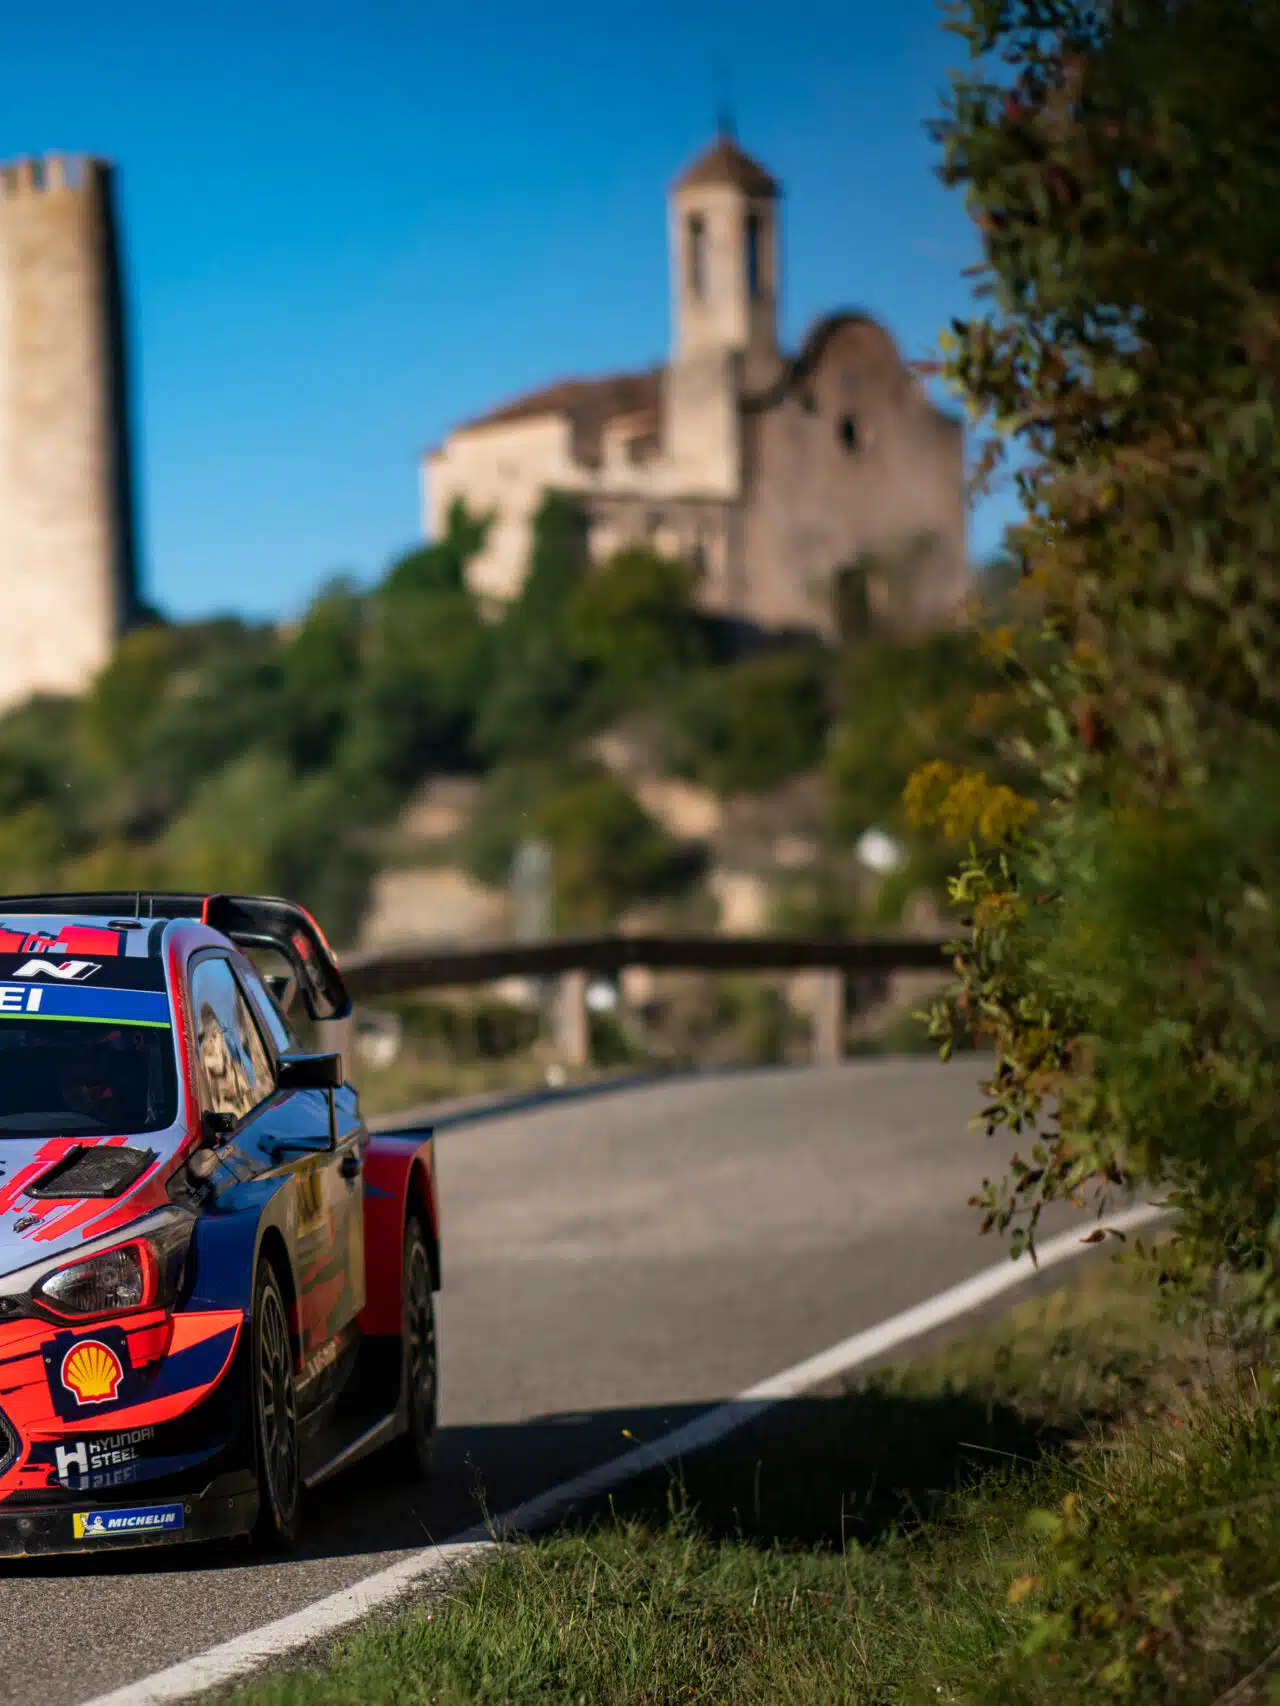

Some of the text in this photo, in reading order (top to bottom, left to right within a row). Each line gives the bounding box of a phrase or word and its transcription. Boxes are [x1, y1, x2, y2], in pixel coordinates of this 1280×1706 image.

[89, 1426, 156, 1454] HYUNDAI
[91, 1447, 140, 1469] STEEL
[107, 1512, 176, 1528] MICHELIN
